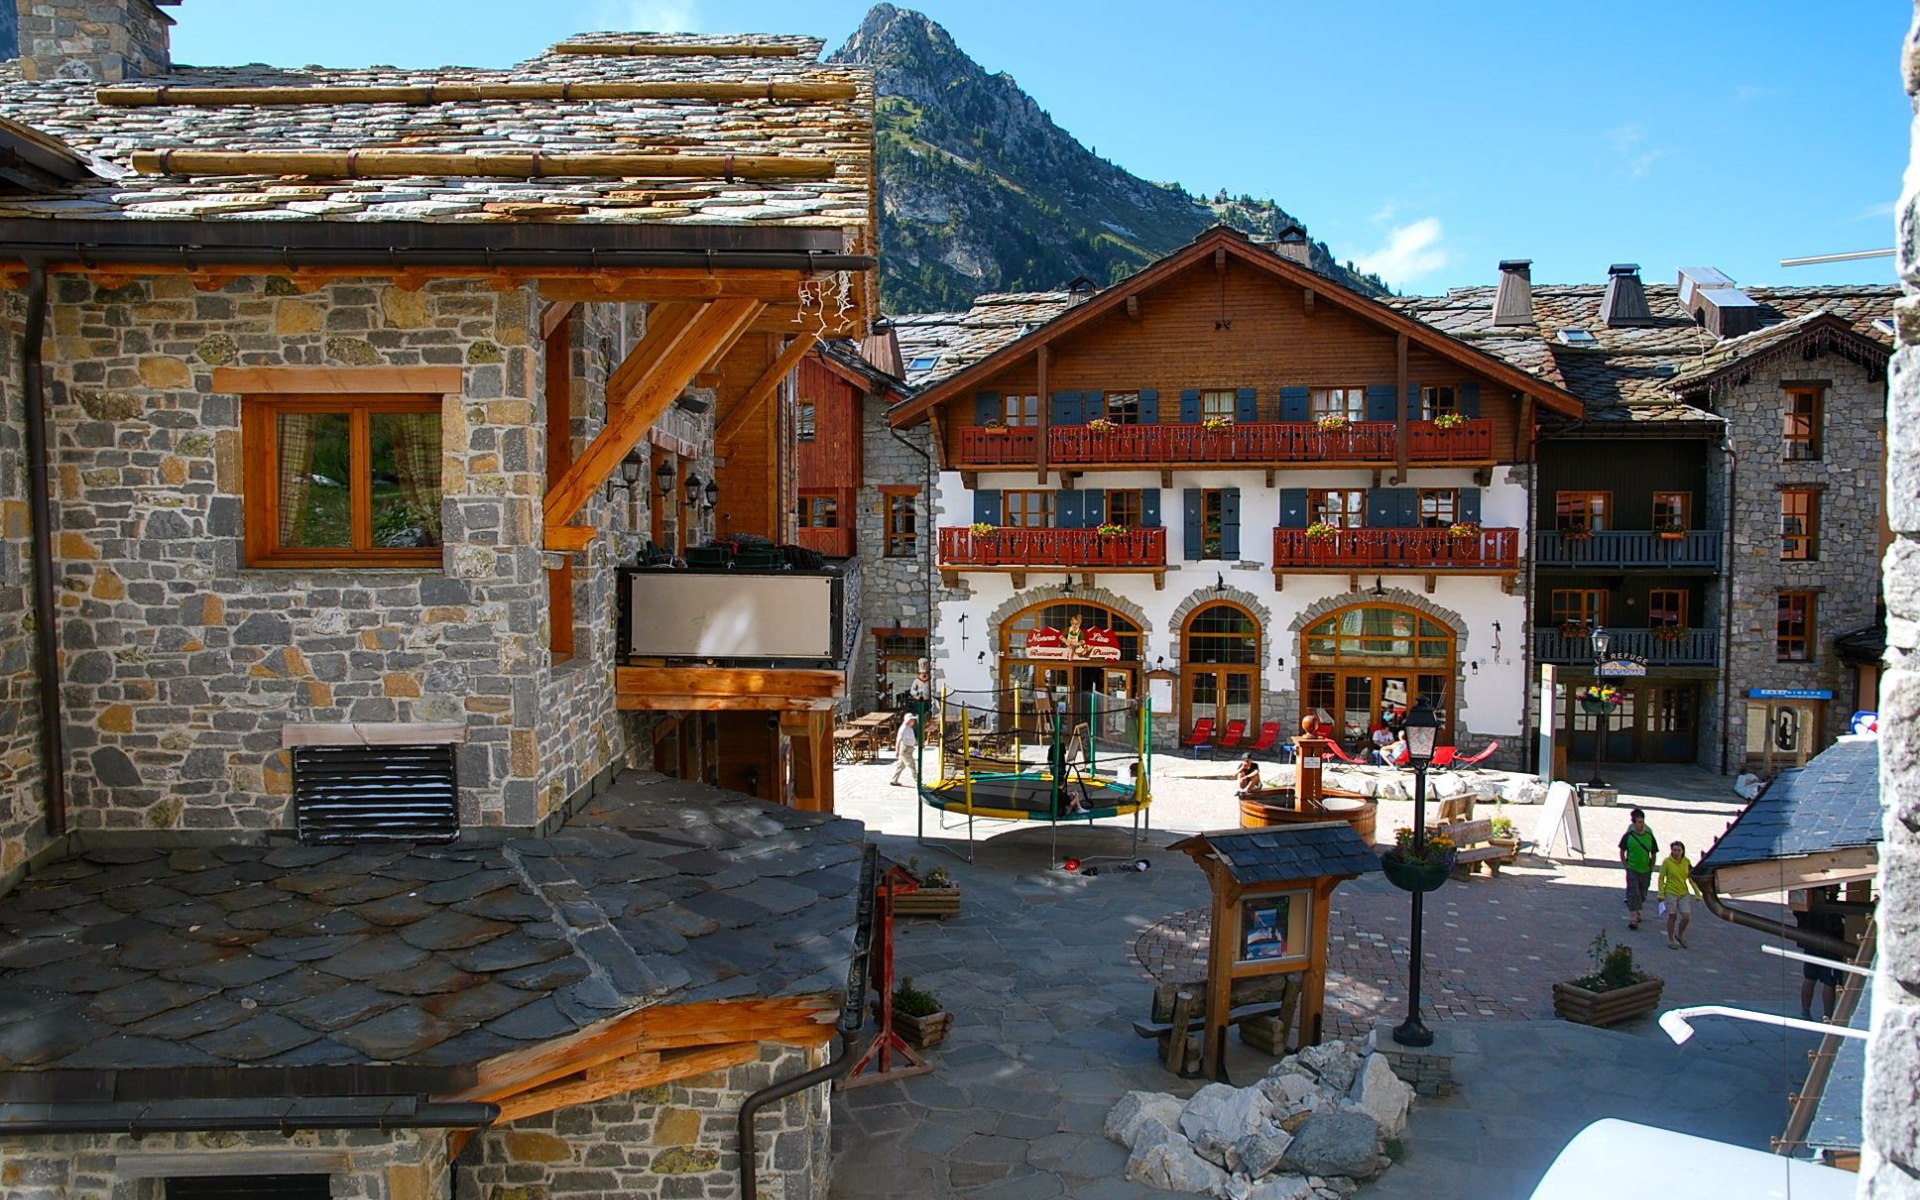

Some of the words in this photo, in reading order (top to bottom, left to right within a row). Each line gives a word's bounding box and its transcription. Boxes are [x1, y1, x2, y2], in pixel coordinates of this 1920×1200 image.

[1028, 633, 1056, 643] Nonna
[1089, 632, 1110, 643] Lisa
[1029, 649, 1064, 657] Restaurant
[1610, 652, 1649, 665] REFUGE
